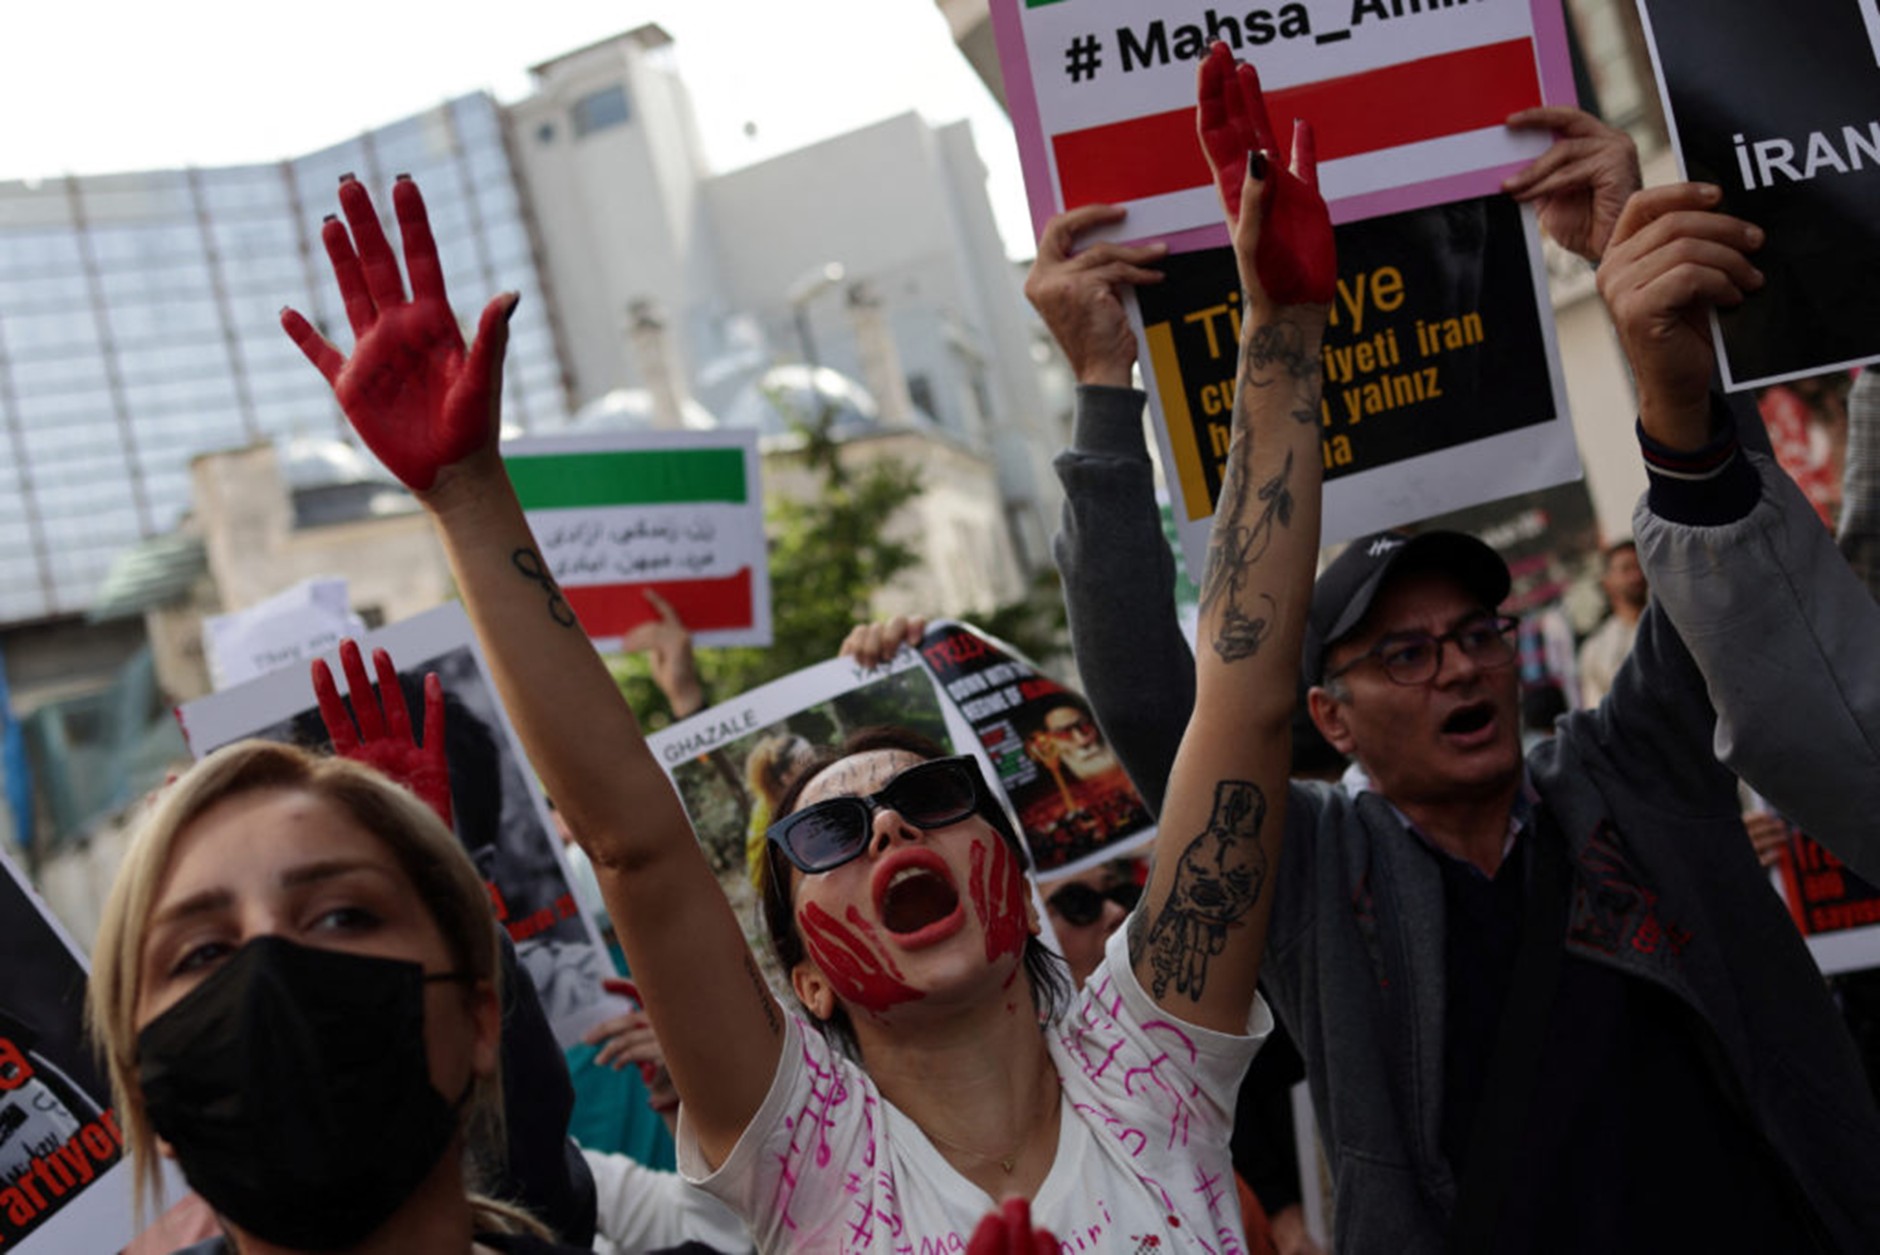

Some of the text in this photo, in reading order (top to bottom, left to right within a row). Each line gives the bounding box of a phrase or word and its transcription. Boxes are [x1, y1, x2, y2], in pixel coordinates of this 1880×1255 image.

[1116, 0, 1485, 72] Mahsa_A
[1733, 121, 1880, 190] İRAN
[1415, 311, 1485, 357] iran
[1343, 366, 1443, 425] yalnız
[663, 708, 758, 763] GHAZALE
